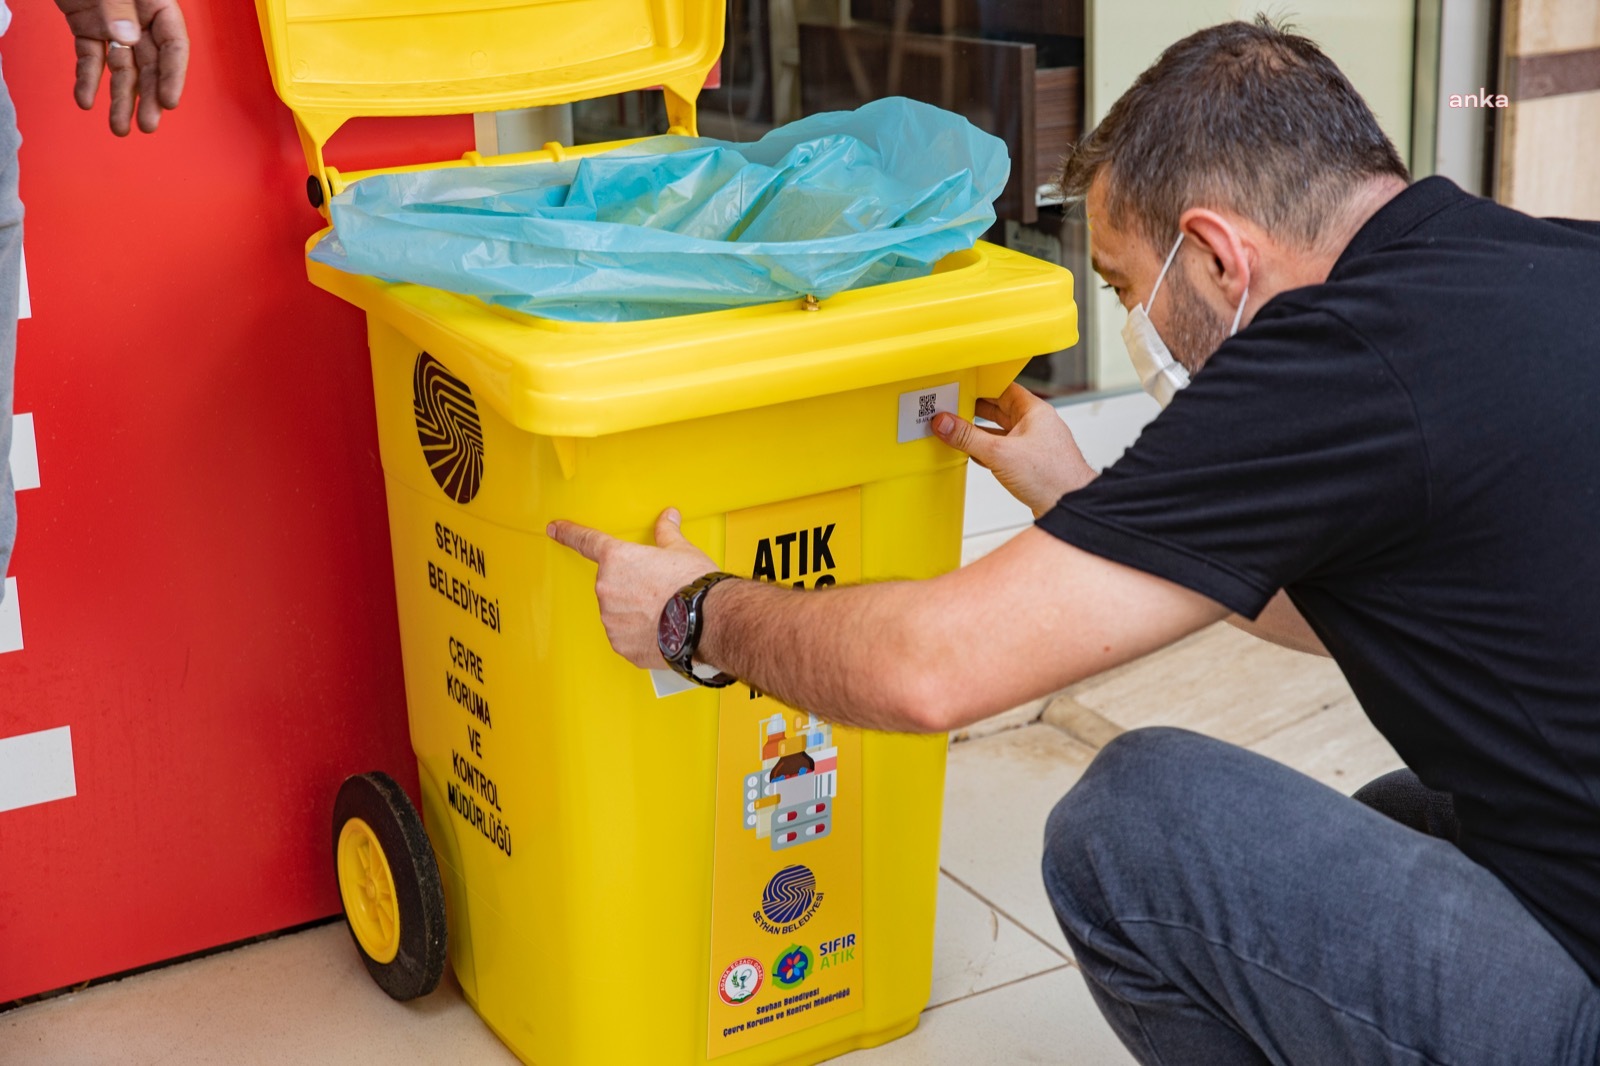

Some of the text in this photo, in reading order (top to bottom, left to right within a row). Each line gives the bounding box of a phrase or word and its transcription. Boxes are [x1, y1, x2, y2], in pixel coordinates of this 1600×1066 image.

[435, 521, 486, 579] SEYHAN
[752, 523, 836, 582] ATIK
[428, 560, 501, 634] BELEDİYESİ
[449, 636, 484, 686] ÇEVRE
[446, 670, 492, 730] KORUMA
[467, 724, 482, 760] VE
[452, 748, 502, 813] KONTROL
[447, 781, 512, 858] MÜDÜRLÜĞÜ
[752, 910, 780, 935] SEYHAN
[819, 933, 856, 957] SIFIR
[819, 947, 855, 971] ATIK
[723, 987, 851, 1038] Çevre Koruma ve Kontrol Müdürlüğü
[756, 987, 820, 1015] Seyhan Belediyesi
